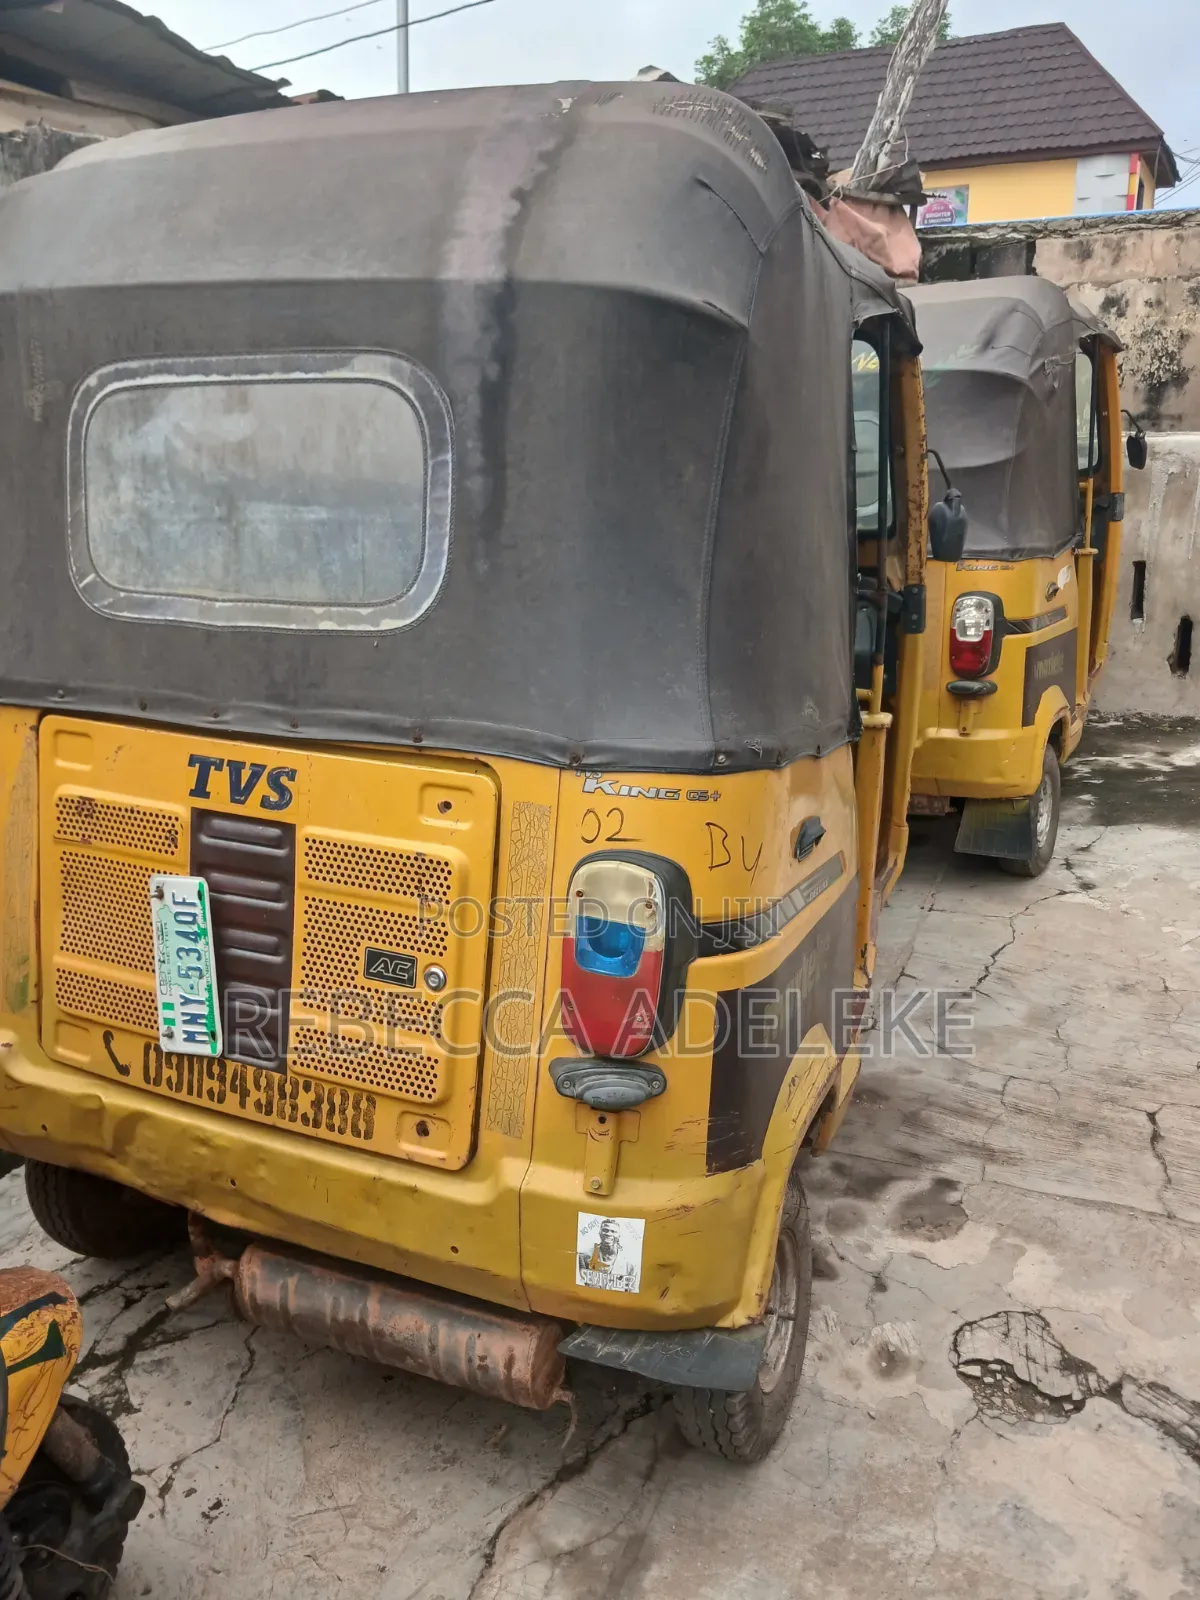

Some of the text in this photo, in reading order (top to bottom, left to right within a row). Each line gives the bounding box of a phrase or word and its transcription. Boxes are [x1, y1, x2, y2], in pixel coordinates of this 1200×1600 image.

[187, 753, 298, 811] TVS
[686, 789, 722, 801] GS+
[369, 957, 412, 979] AC
